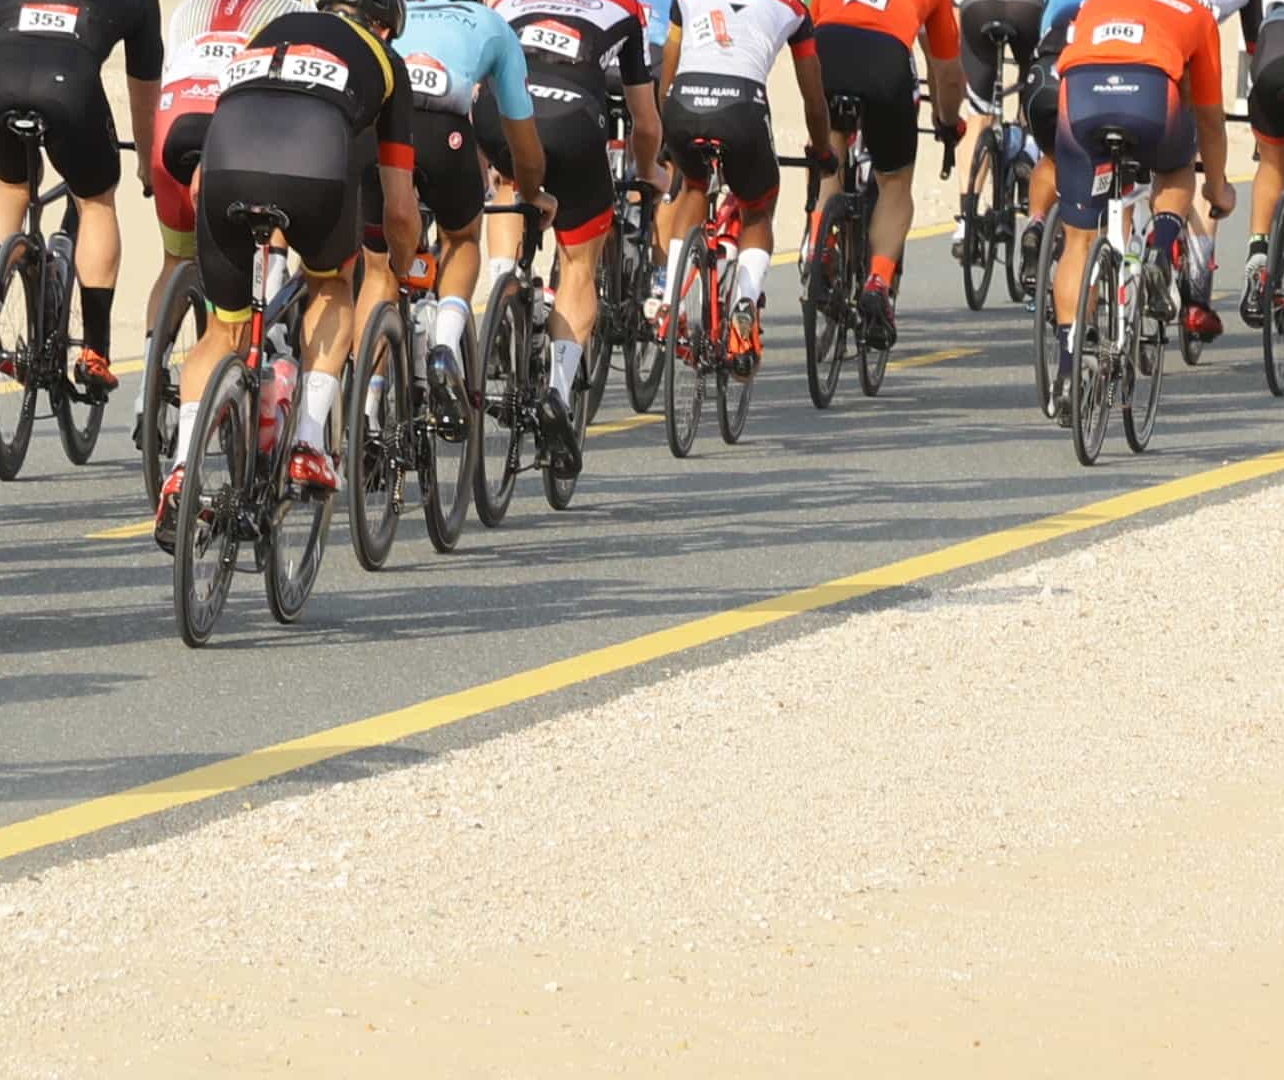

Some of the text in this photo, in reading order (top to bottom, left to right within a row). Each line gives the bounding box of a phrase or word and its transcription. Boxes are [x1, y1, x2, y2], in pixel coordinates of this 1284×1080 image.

[28, 11, 66, 28] 355
[532, 29, 571, 50] 332
[1101, 24, 1134, 39] 366
[199, 44, 237, 59] 383
[292, 59, 339, 82] 352
[411, 68, 438, 89] 98
[528, 83, 583, 103] ANT
